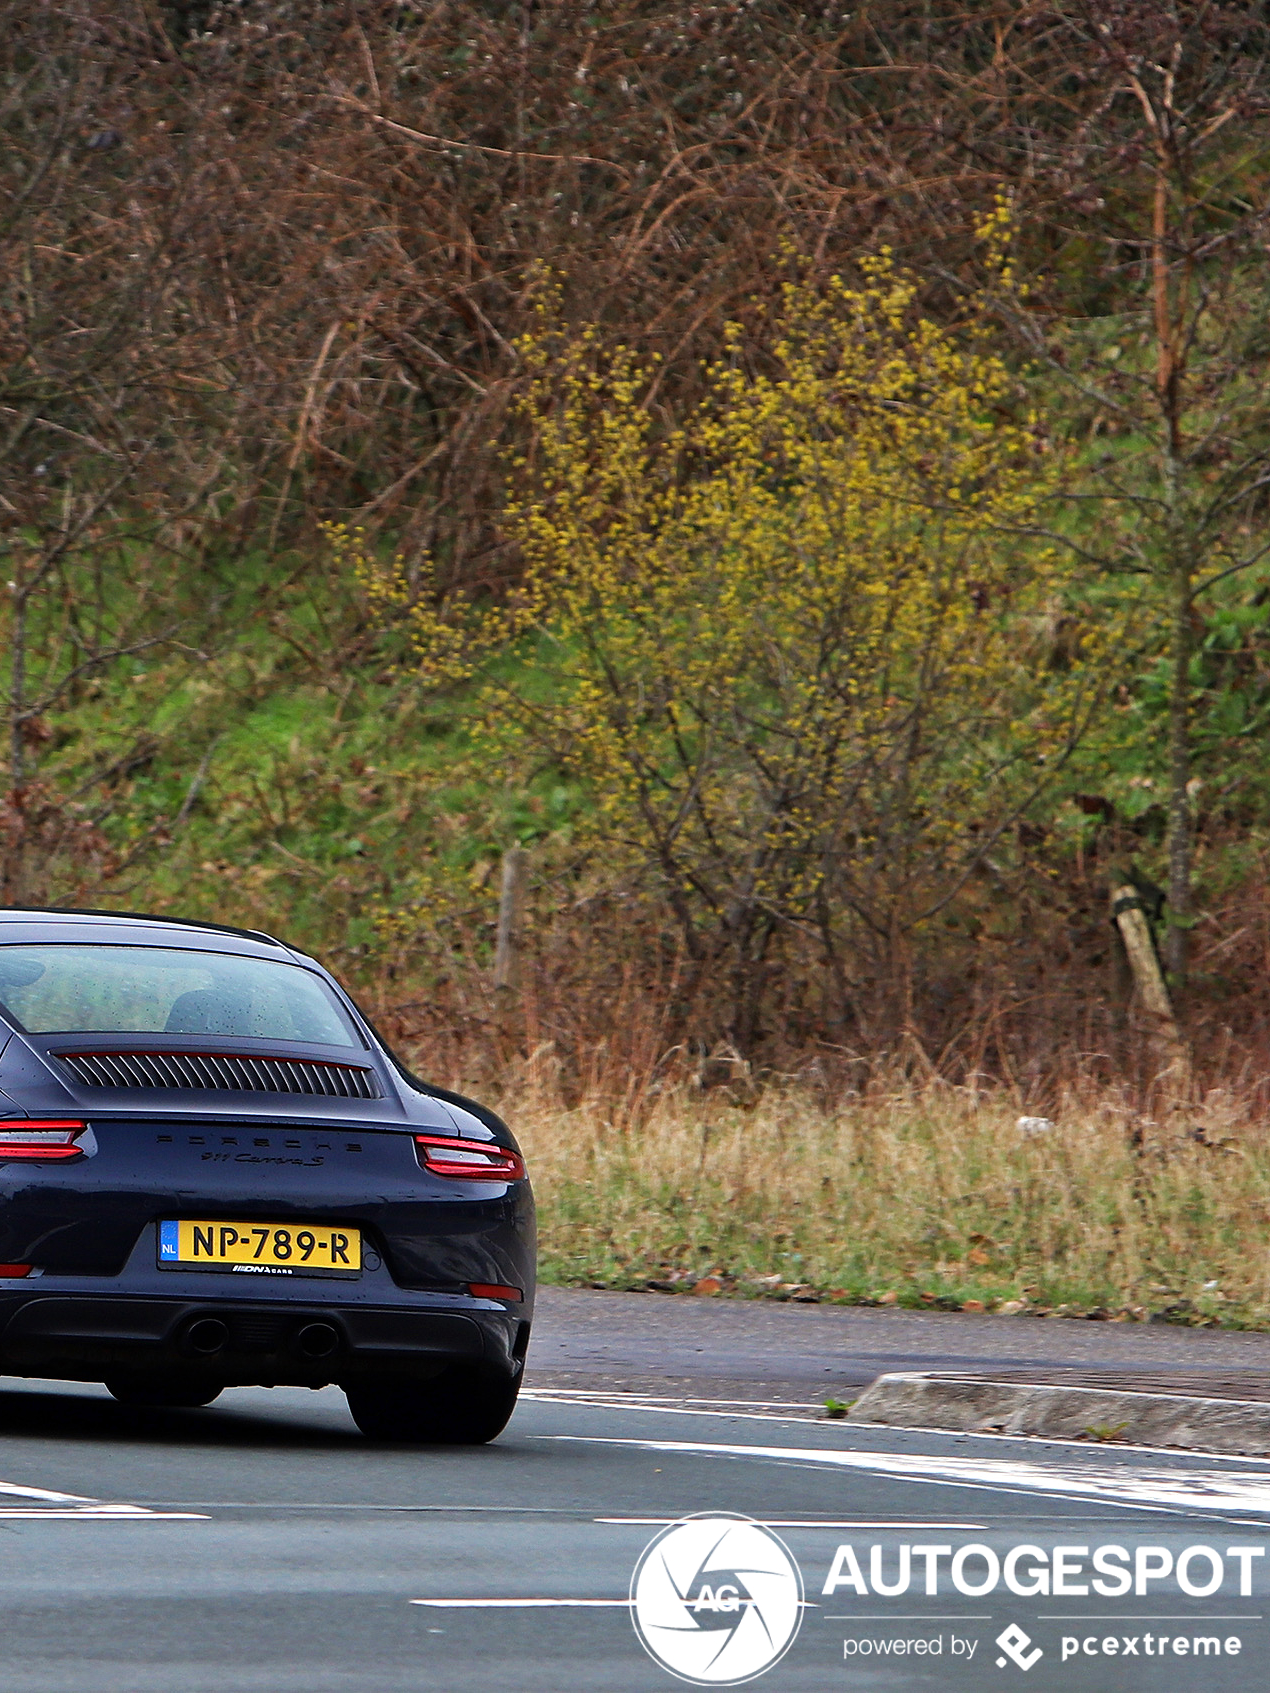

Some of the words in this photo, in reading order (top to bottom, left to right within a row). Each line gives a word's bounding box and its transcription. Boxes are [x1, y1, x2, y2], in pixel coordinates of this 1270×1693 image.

[157, 1135, 362, 1152] PORSCHE
[201, 1151, 230, 1162] 911
[234, 1153, 304, 1165] Carrera
[162, 1244, 176, 1254] NL
[193, 1226, 350, 1264] NP-789-R
